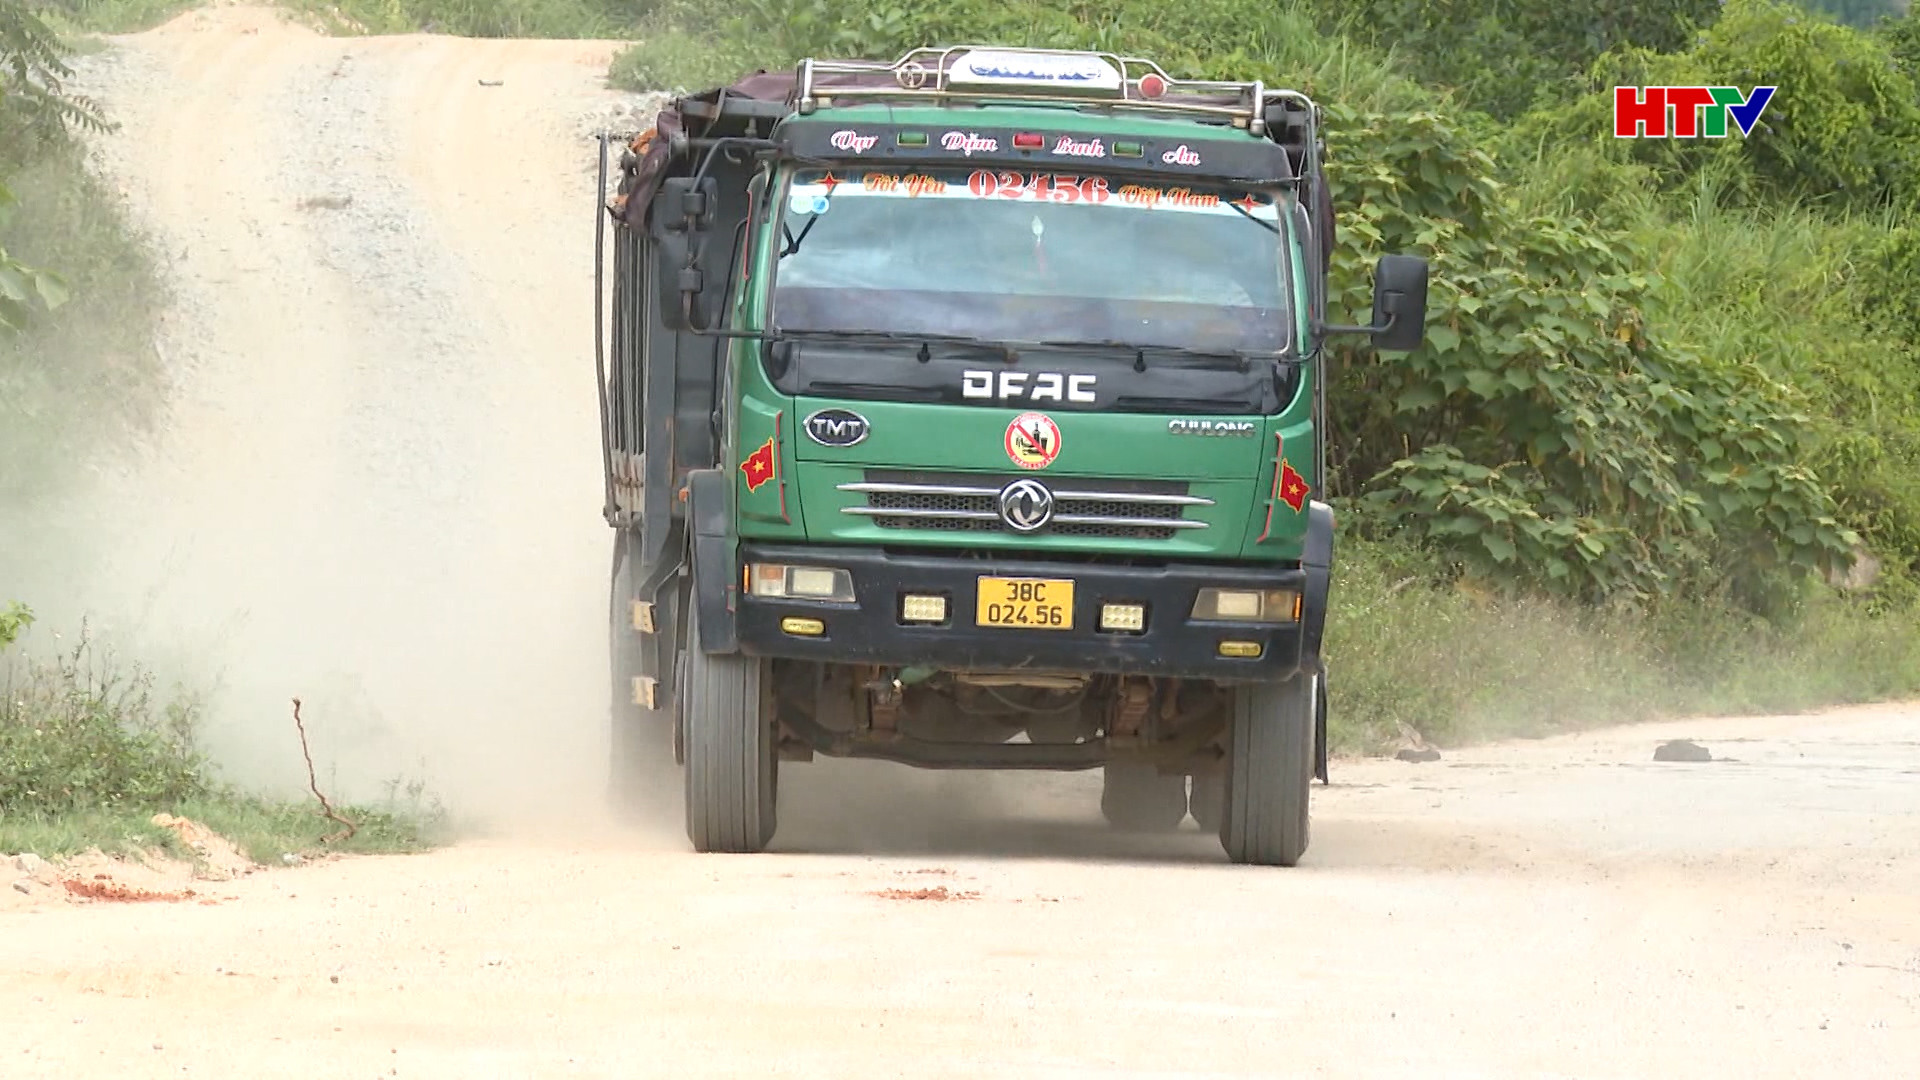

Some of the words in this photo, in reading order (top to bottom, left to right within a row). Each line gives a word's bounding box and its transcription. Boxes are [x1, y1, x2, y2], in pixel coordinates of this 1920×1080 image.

[1162, 145, 1201, 167] An
[967, 169, 1110, 204] 02456
[1167, 187, 1220, 208] Nam
[963, 370, 1097, 402] DFAC
[813, 418, 861, 436] TMT
[1006, 582, 1046, 602] 38C
[988, 603, 1062, 625] 024.56
